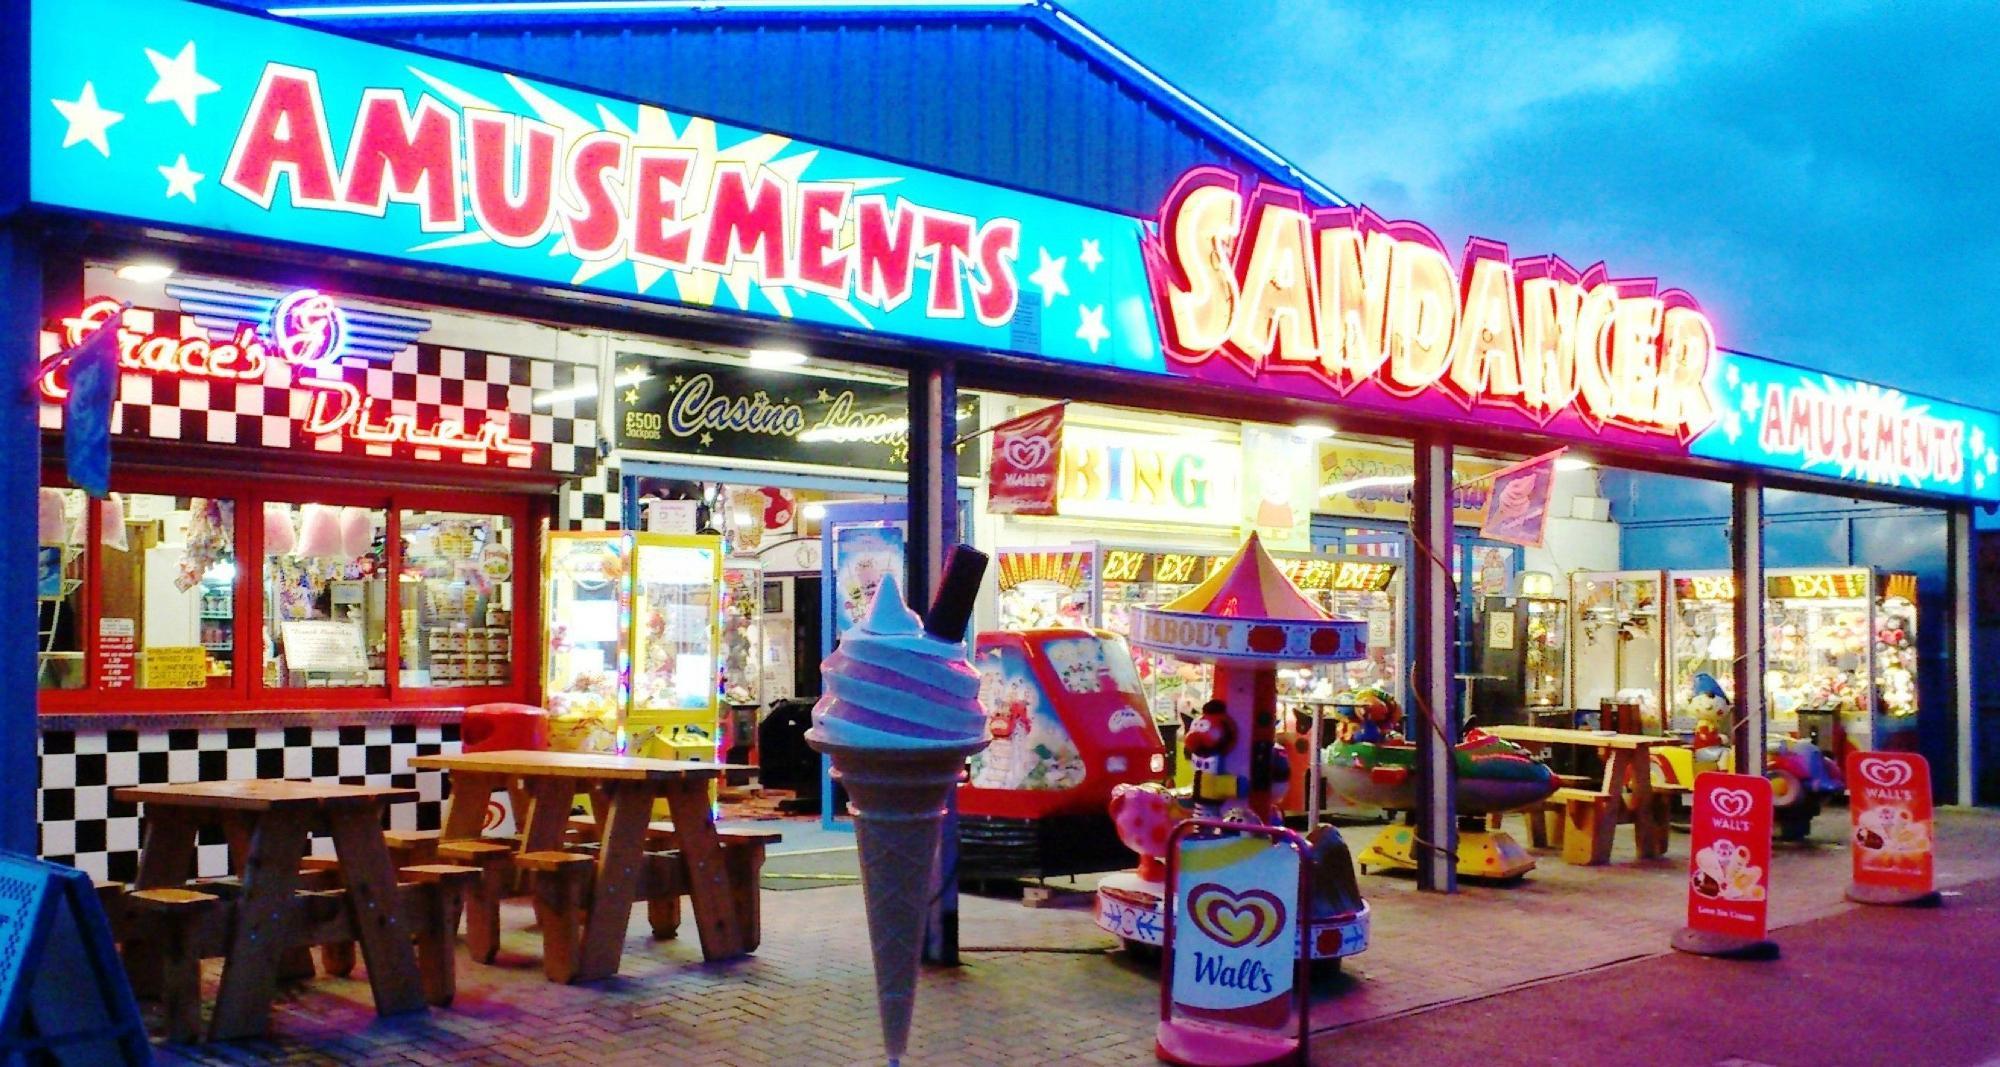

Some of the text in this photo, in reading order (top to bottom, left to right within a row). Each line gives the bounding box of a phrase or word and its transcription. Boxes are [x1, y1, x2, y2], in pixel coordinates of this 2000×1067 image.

[220, 62, 1020, 328] AMUSEMENTS
[1166, 176, 1720, 437] SANDANCER
[300, 376, 534, 455] Diner
[626, 411, 661, 430] £500
[667, 373, 805, 438] Casino
[1761, 386, 1961, 480] AMUSEMENTS
[1711, 817, 1751, 832] WALL'S
[1864, 787, 1912, 802] WALL'S
[1193, 951, 1274, 994] Wall's
